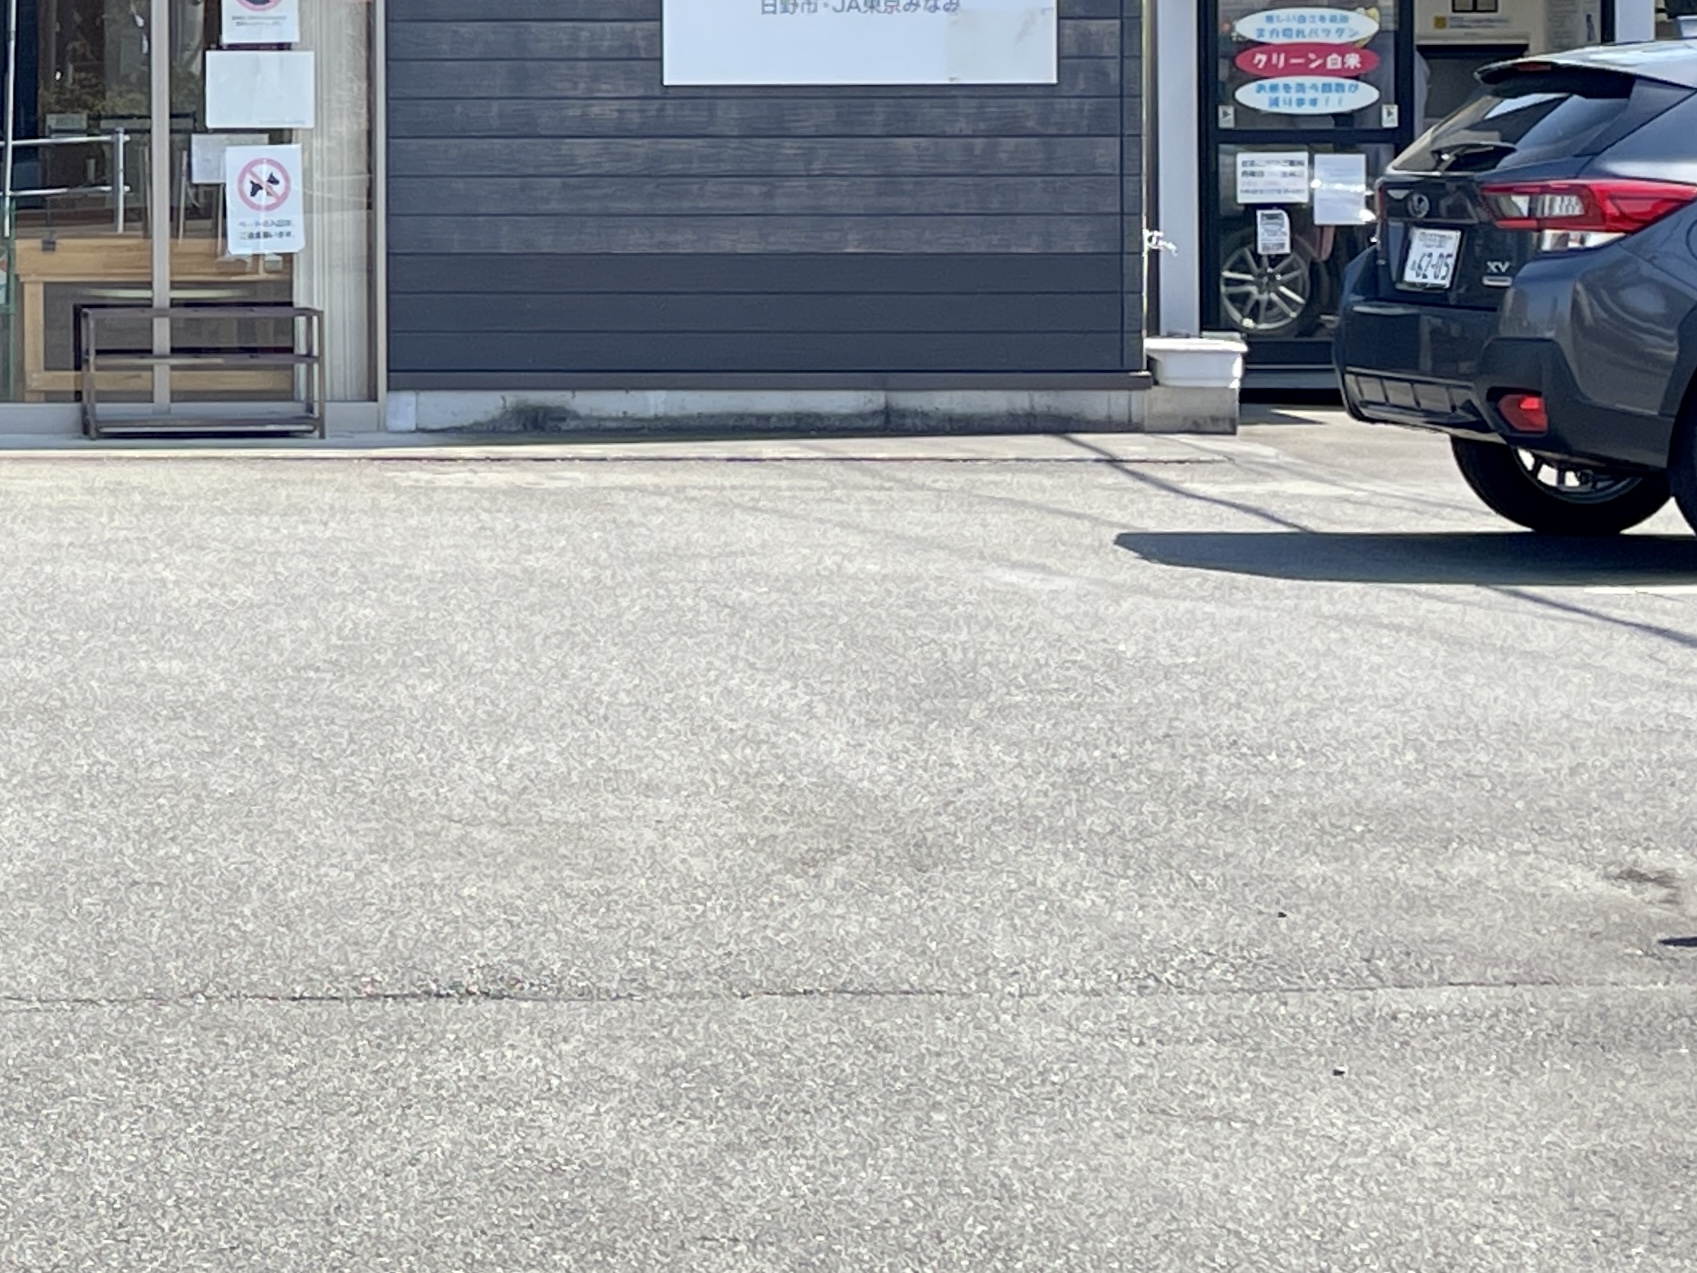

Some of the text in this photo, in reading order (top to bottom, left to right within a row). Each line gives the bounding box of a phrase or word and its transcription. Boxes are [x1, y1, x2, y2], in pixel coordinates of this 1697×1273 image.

[1252, 52, 1362, 70] クリーン白米
